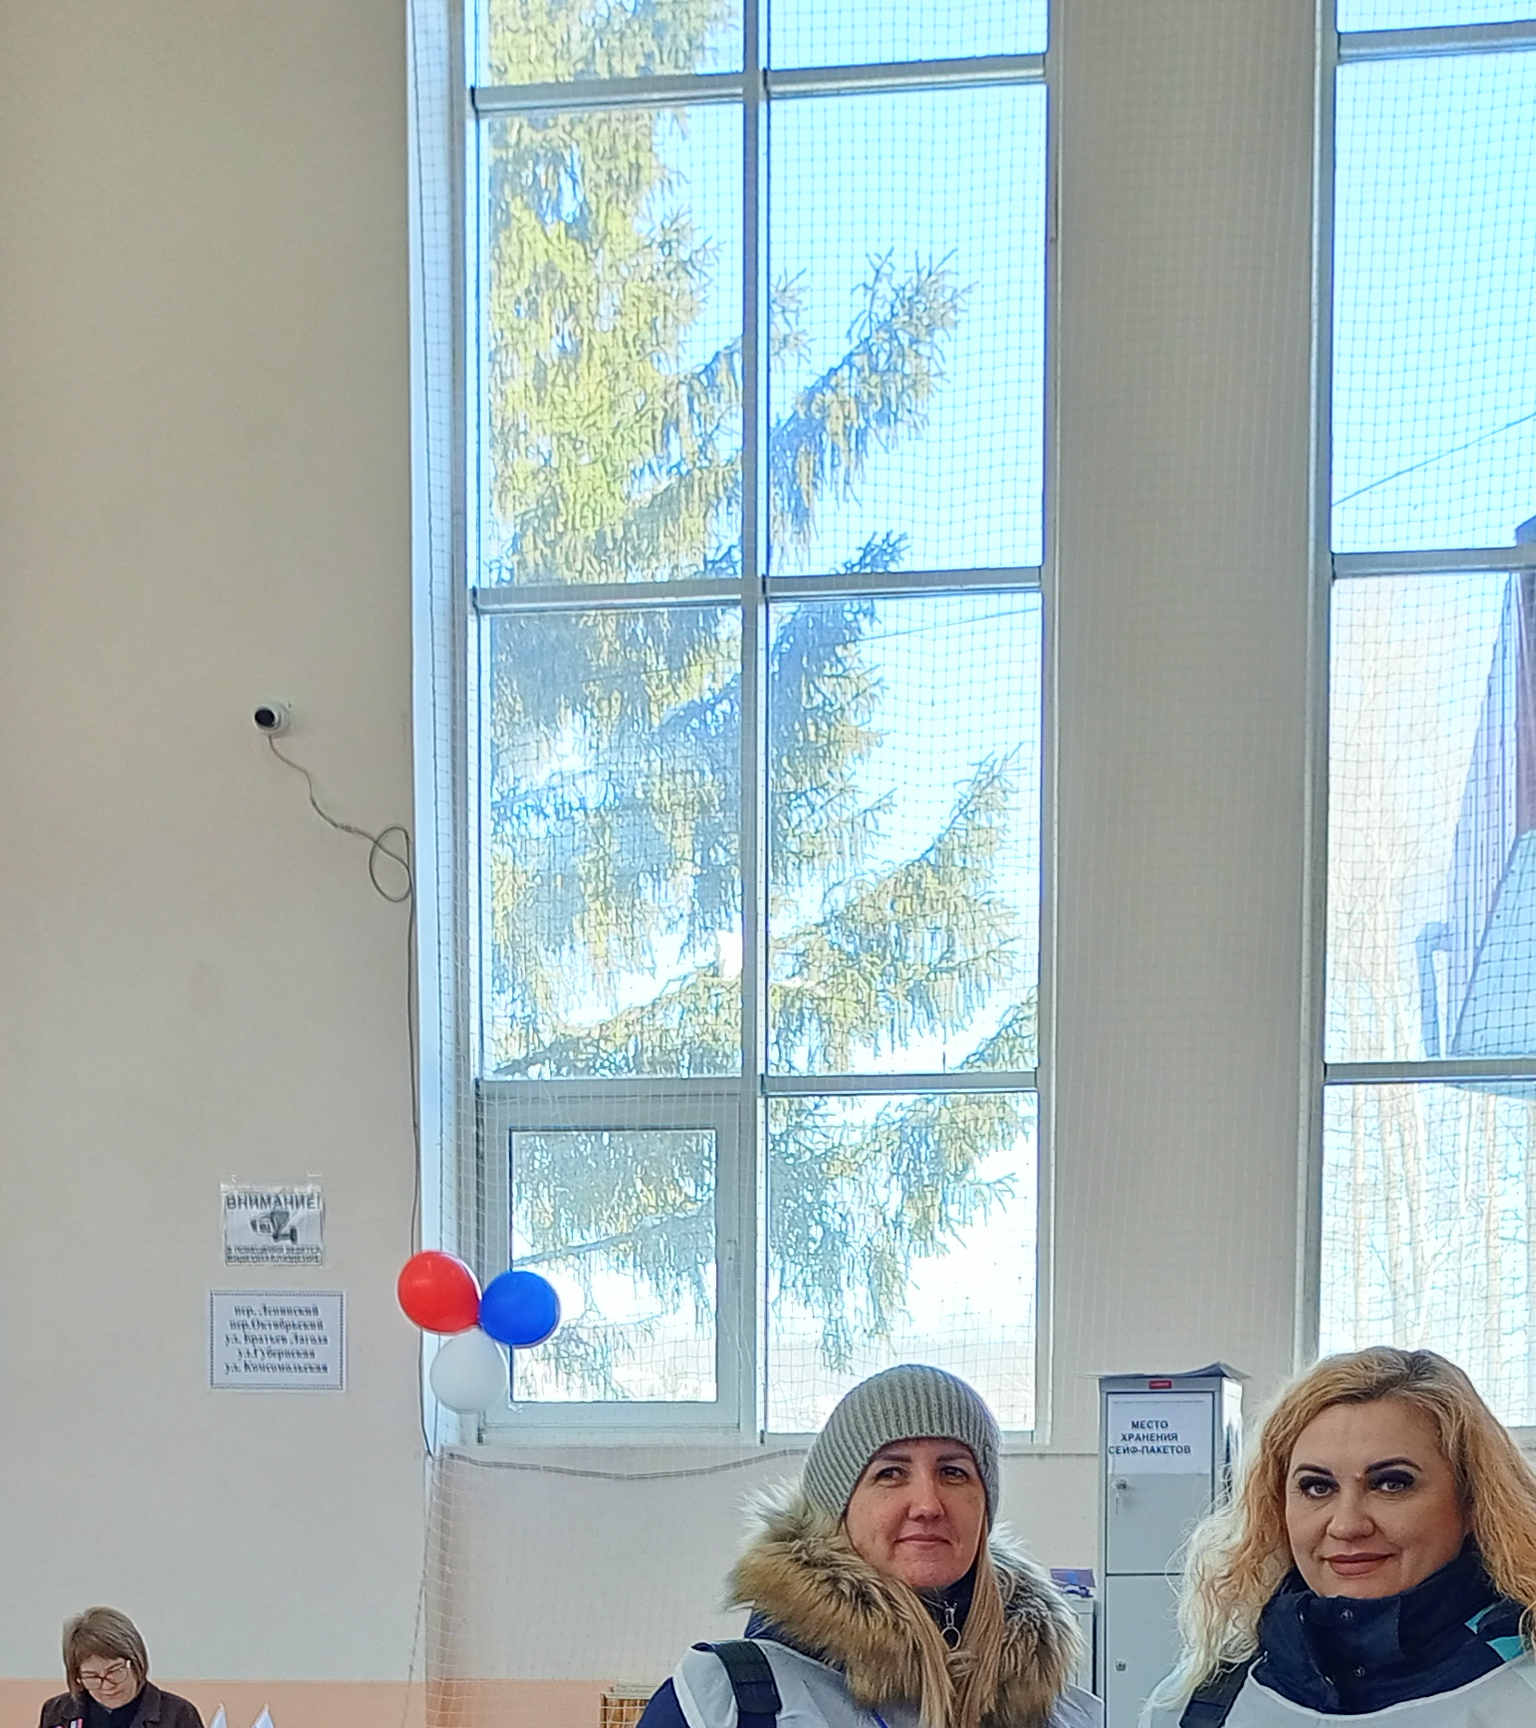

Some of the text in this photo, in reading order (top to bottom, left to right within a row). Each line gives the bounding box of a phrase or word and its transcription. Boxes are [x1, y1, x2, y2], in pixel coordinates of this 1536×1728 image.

[226, 1194, 320, 1210] ВНИМАНИЕ!
[1131, 1420, 1168, 1429] МЕСТО
[1120, 1433, 1178, 1442] ХРАНЕНИЯ
[1108, 1444, 1191, 1455] СЕЙФ-ПАКЕТОВ
